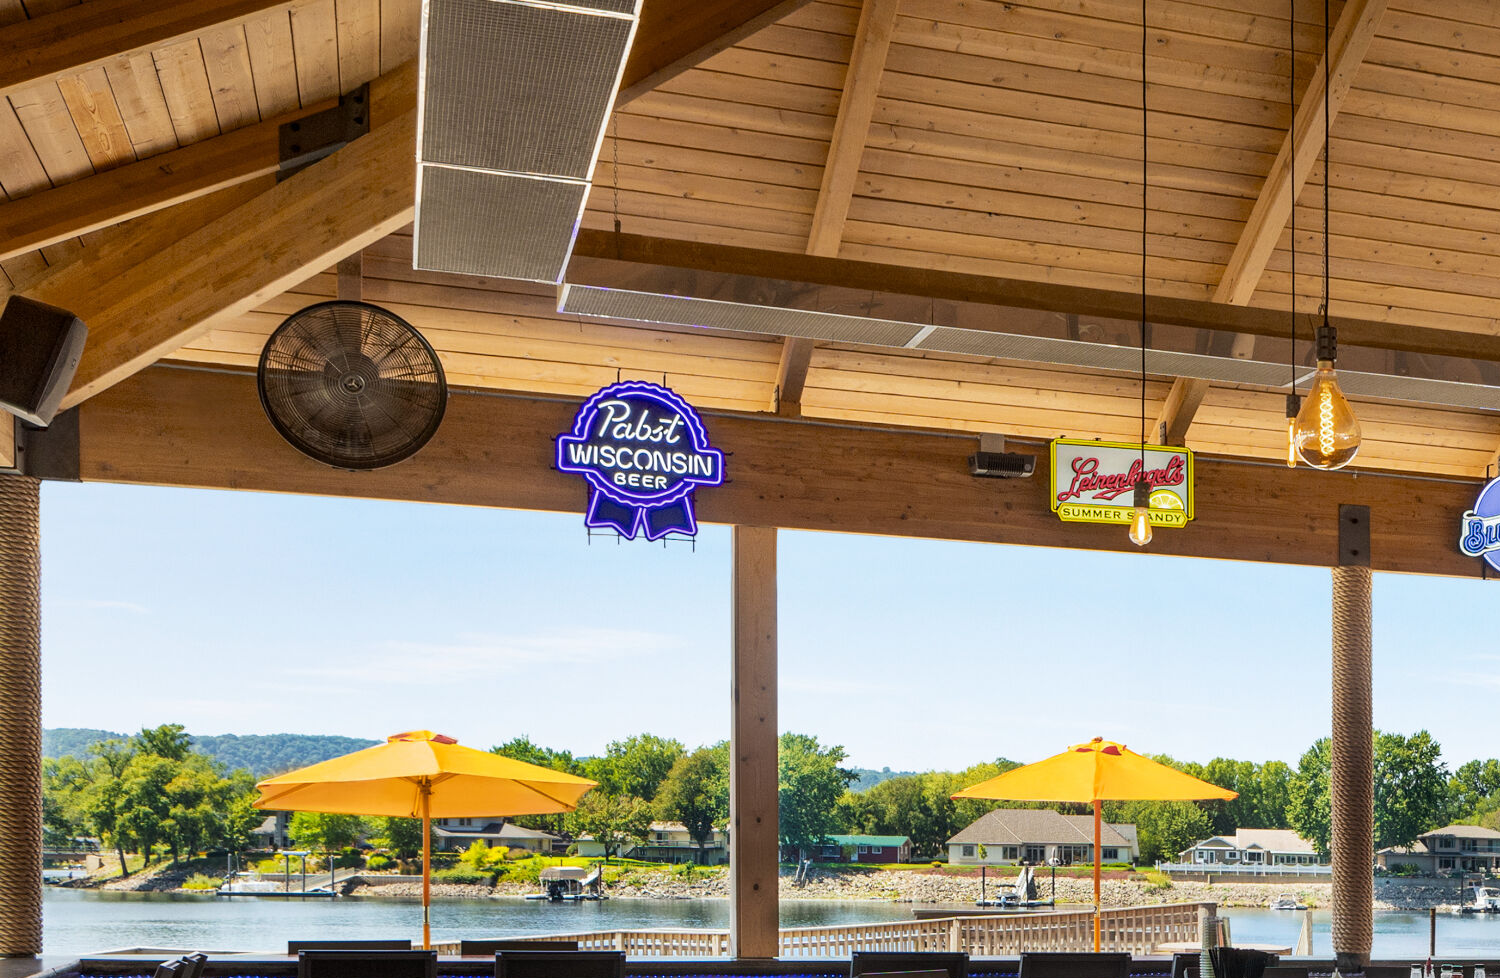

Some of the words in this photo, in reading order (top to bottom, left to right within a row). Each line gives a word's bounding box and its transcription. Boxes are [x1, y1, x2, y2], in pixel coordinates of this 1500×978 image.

[598, 400, 684, 443] Pabst
[569, 443, 712, 476] WISCONSIN
[614, 472, 667, 489] BEER
[1062, 508, 1121, 519] SUMMER
[1127, 512, 1182, 522] SANDY
